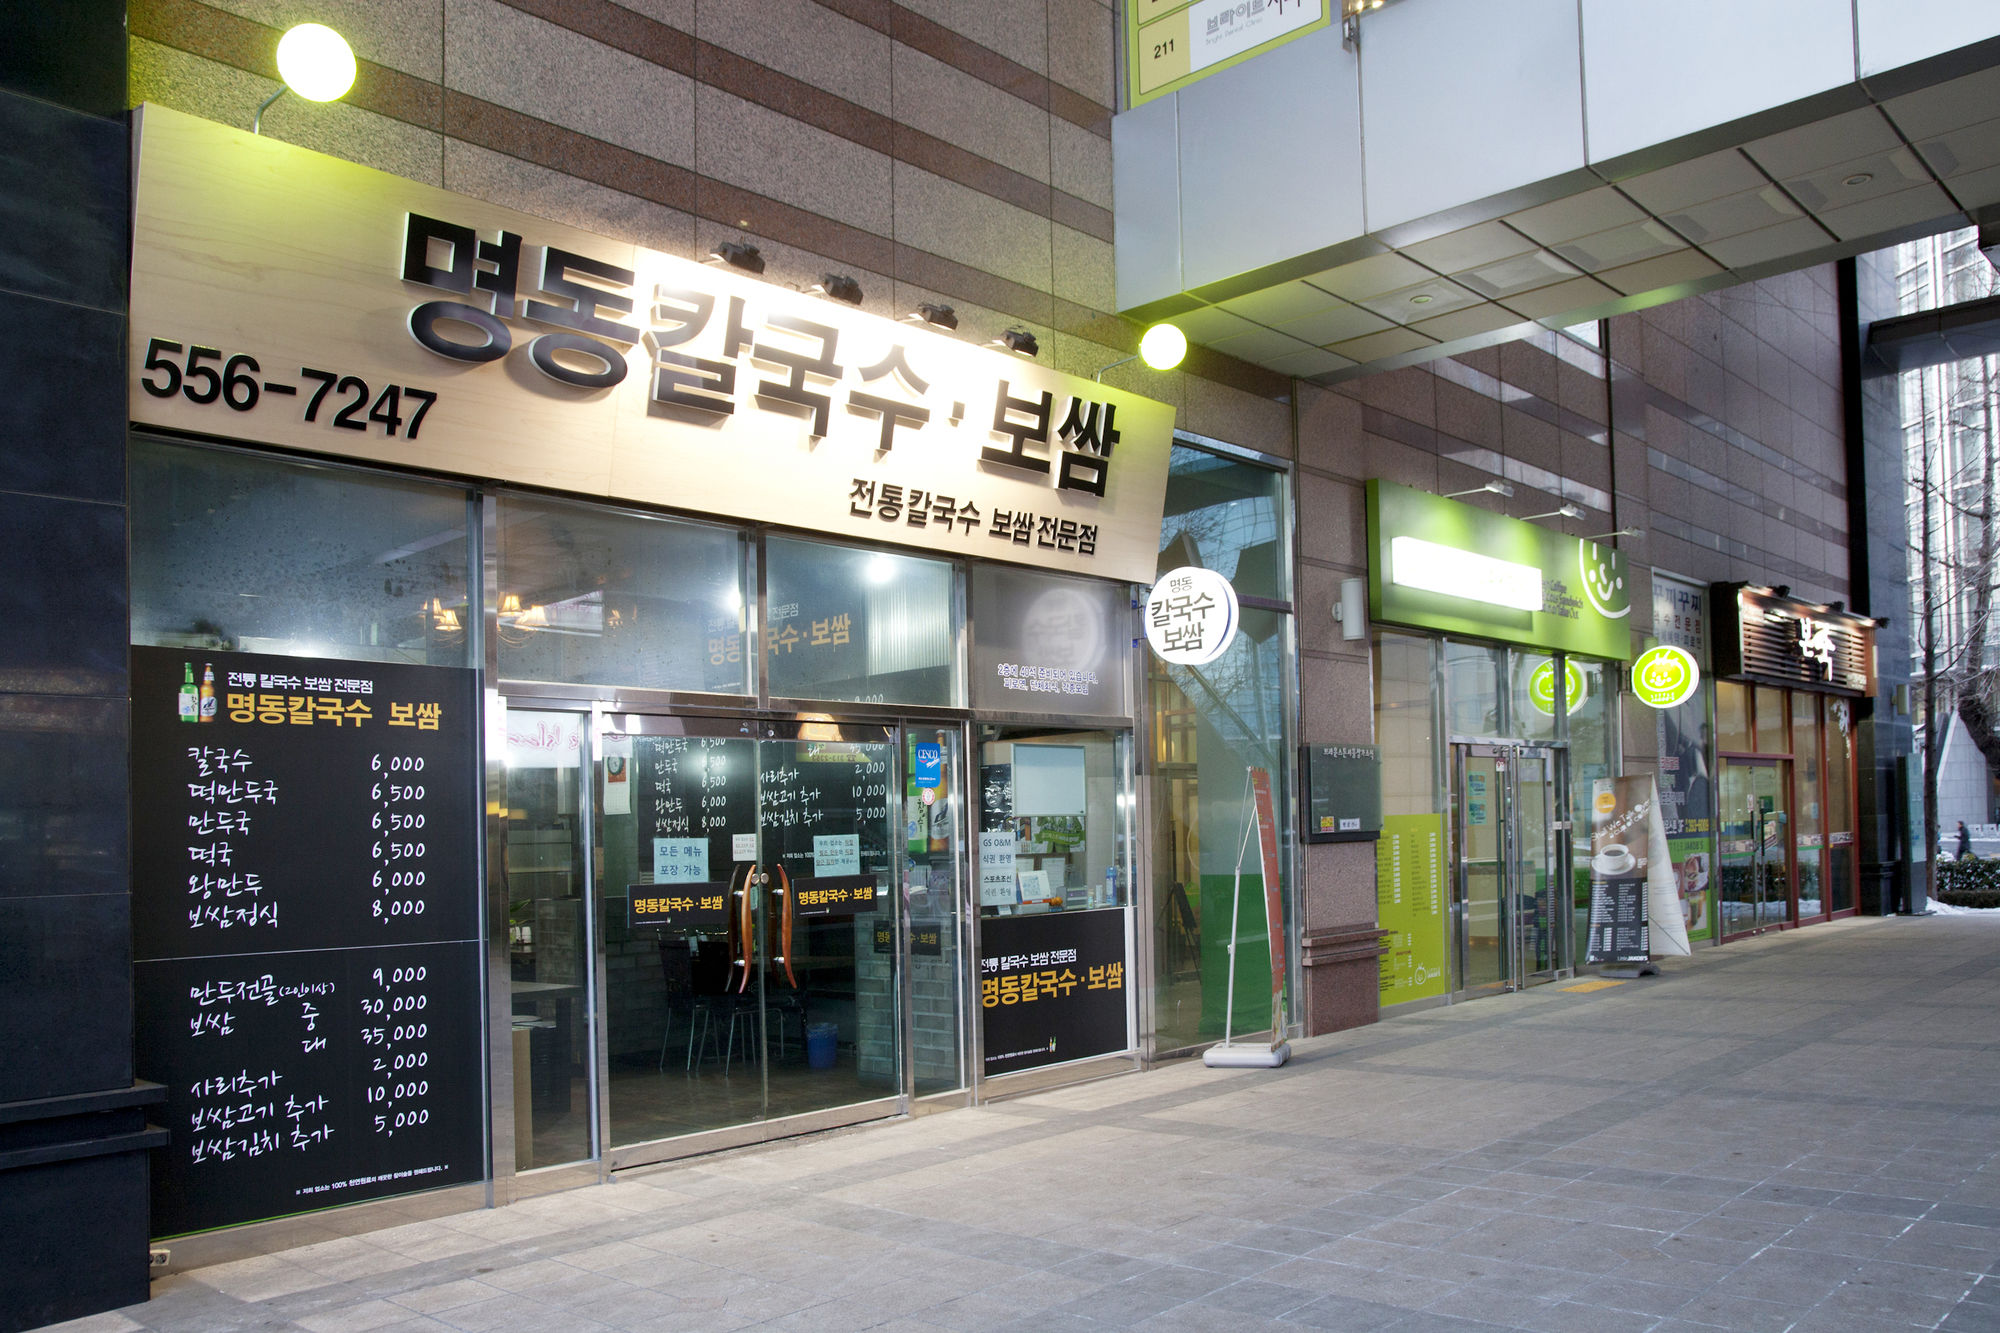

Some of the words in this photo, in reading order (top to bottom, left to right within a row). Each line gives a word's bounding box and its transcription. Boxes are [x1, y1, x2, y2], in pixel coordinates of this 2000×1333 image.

[1154, 39, 1174, 59] 211
[141, 337, 437, 439] 556-7247
[989, 507, 1034, 544] 보쌈
[1036, 515, 1098, 555] 전문점
[1170, 576, 1193, 594] 명동
[1151, 592, 1215, 628] 칼국수
[1163, 622, 1204, 652] 보쌈
[228, 672, 256, 687] 전통
[260, 674, 301, 690] 칼국수
[304, 677, 332, 692] 보쌈
[334, 679, 373, 694] 전문점
[998, 663, 1018, 677] 2층에
[1020, 665, 1037, 679] 40석
[227, 693, 373, 727] 명동칼국수
[388, 702, 441, 730] 보쌈
[188, 746, 252, 777] 칼국수
[371, 754, 424, 779] 6,000
[855, 762, 885, 780] 2,000
[188, 780, 278, 804] 떡만두국
[371, 783, 425, 808] 6,500
[702, 776, 726, 792] 6,500
[853, 784, 885, 803] 10,000
[702, 796, 726, 813] 6,000
[856, 807, 885, 825] 5,000
[189, 811, 251, 835] 만두국
[371, 813, 425, 837] 6,500
[702, 816, 726, 832] 8,000
[188, 842, 232, 867] 떡국
[371, 842, 425, 866] 6,500
[660, 846, 678, 857] 모든
[683, 846, 702, 857] 메뉴
[983, 839, 992, 847] GS
[661, 865, 678, 876] 포장
[683, 865, 701, 876] 가능
[189, 873, 263, 900] 왕만두
[372, 871, 425, 895] 6,000
[189, 901, 278, 929] 보쌈정식
[372, 900, 425, 925] 8,000
[1000, 953, 1028, 971] 칼국수
[1030, 952, 1049, 967] 보쌈
[1050, 949, 1077, 965] 전문점
[372, 966, 427, 992] 9,000
[190, 1012, 235, 1037] 보쌈
[301, 1002, 319, 1031] 중
[361, 995, 427, 1021] 30,000
[301, 1037, 326, 1053] 대
[361, 1024, 427, 1049] 35,000
[191, 1070, 283, 1098] 사리추가
[372, 1052, 428, 1078] 2,000
[191, 1101, 275, 1133] 보쌈고기
[285, 1094, 329, 1121] 추가
[367, 1081, 428, 1107] 10,000
[191, 1131, 280, 1164] 보쌈김치
[290, 1124, 335, 1151] 추가
[374, 1109, 429, 1137] 5,000
[331, 1180, 348, 1190] 100%
